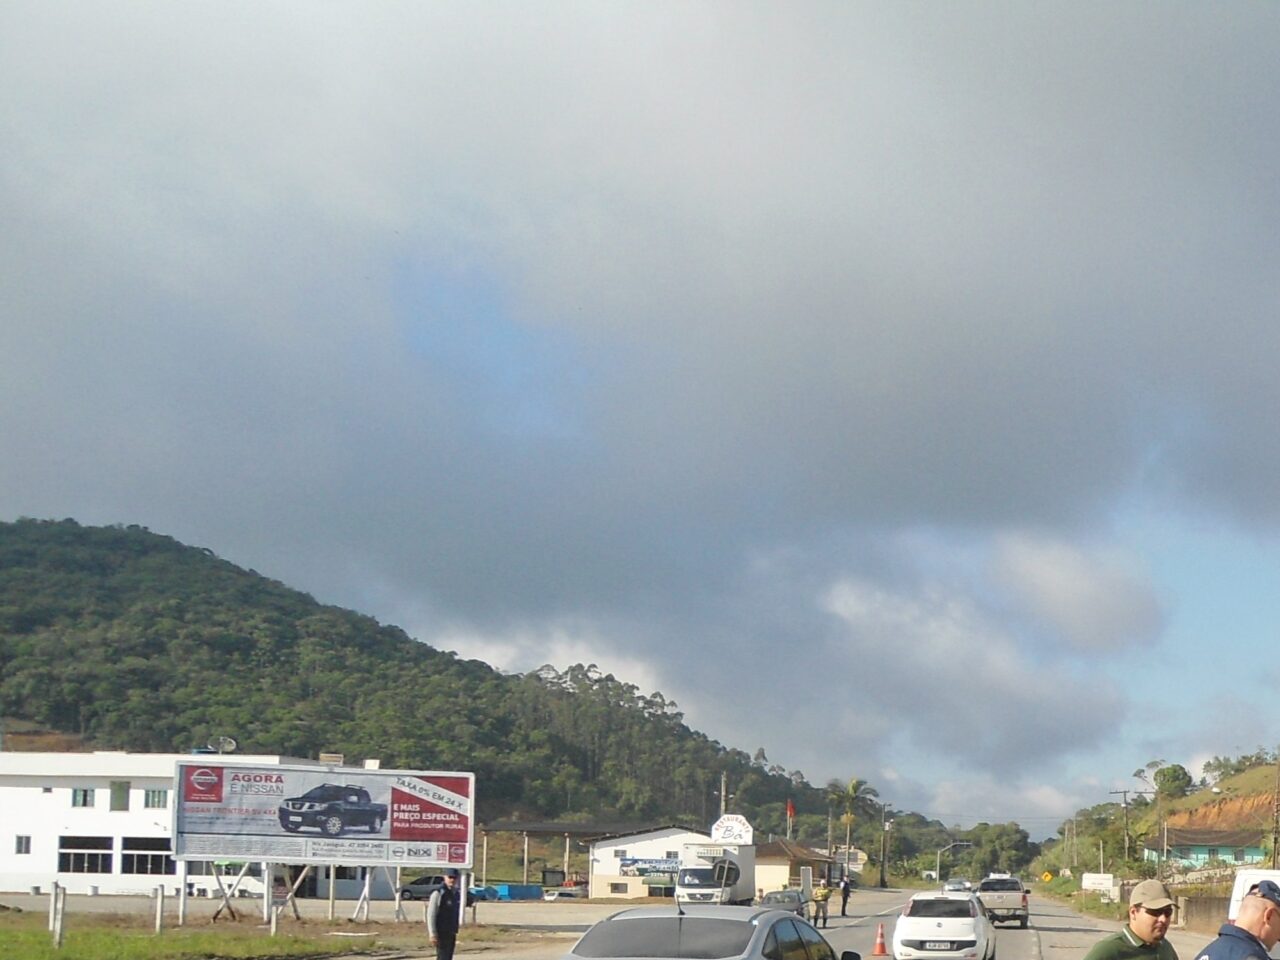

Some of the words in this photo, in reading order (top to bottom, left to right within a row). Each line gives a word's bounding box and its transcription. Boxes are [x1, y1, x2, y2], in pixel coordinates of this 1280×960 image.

[231, 774, 284, 784] AGORA
[230, 784, 237, 793] E
[241, 783, 285, 794] NISSAN
[395, 777, 417, 791] TAXA
[417, 787, 430, 796] 0%
[431, 791, 445, 801] EM
[445, 797, 455, 806] 24
[393, 812, 421, 821] PREÇO
[714, 815, 751, 833] RESTAURANTE
